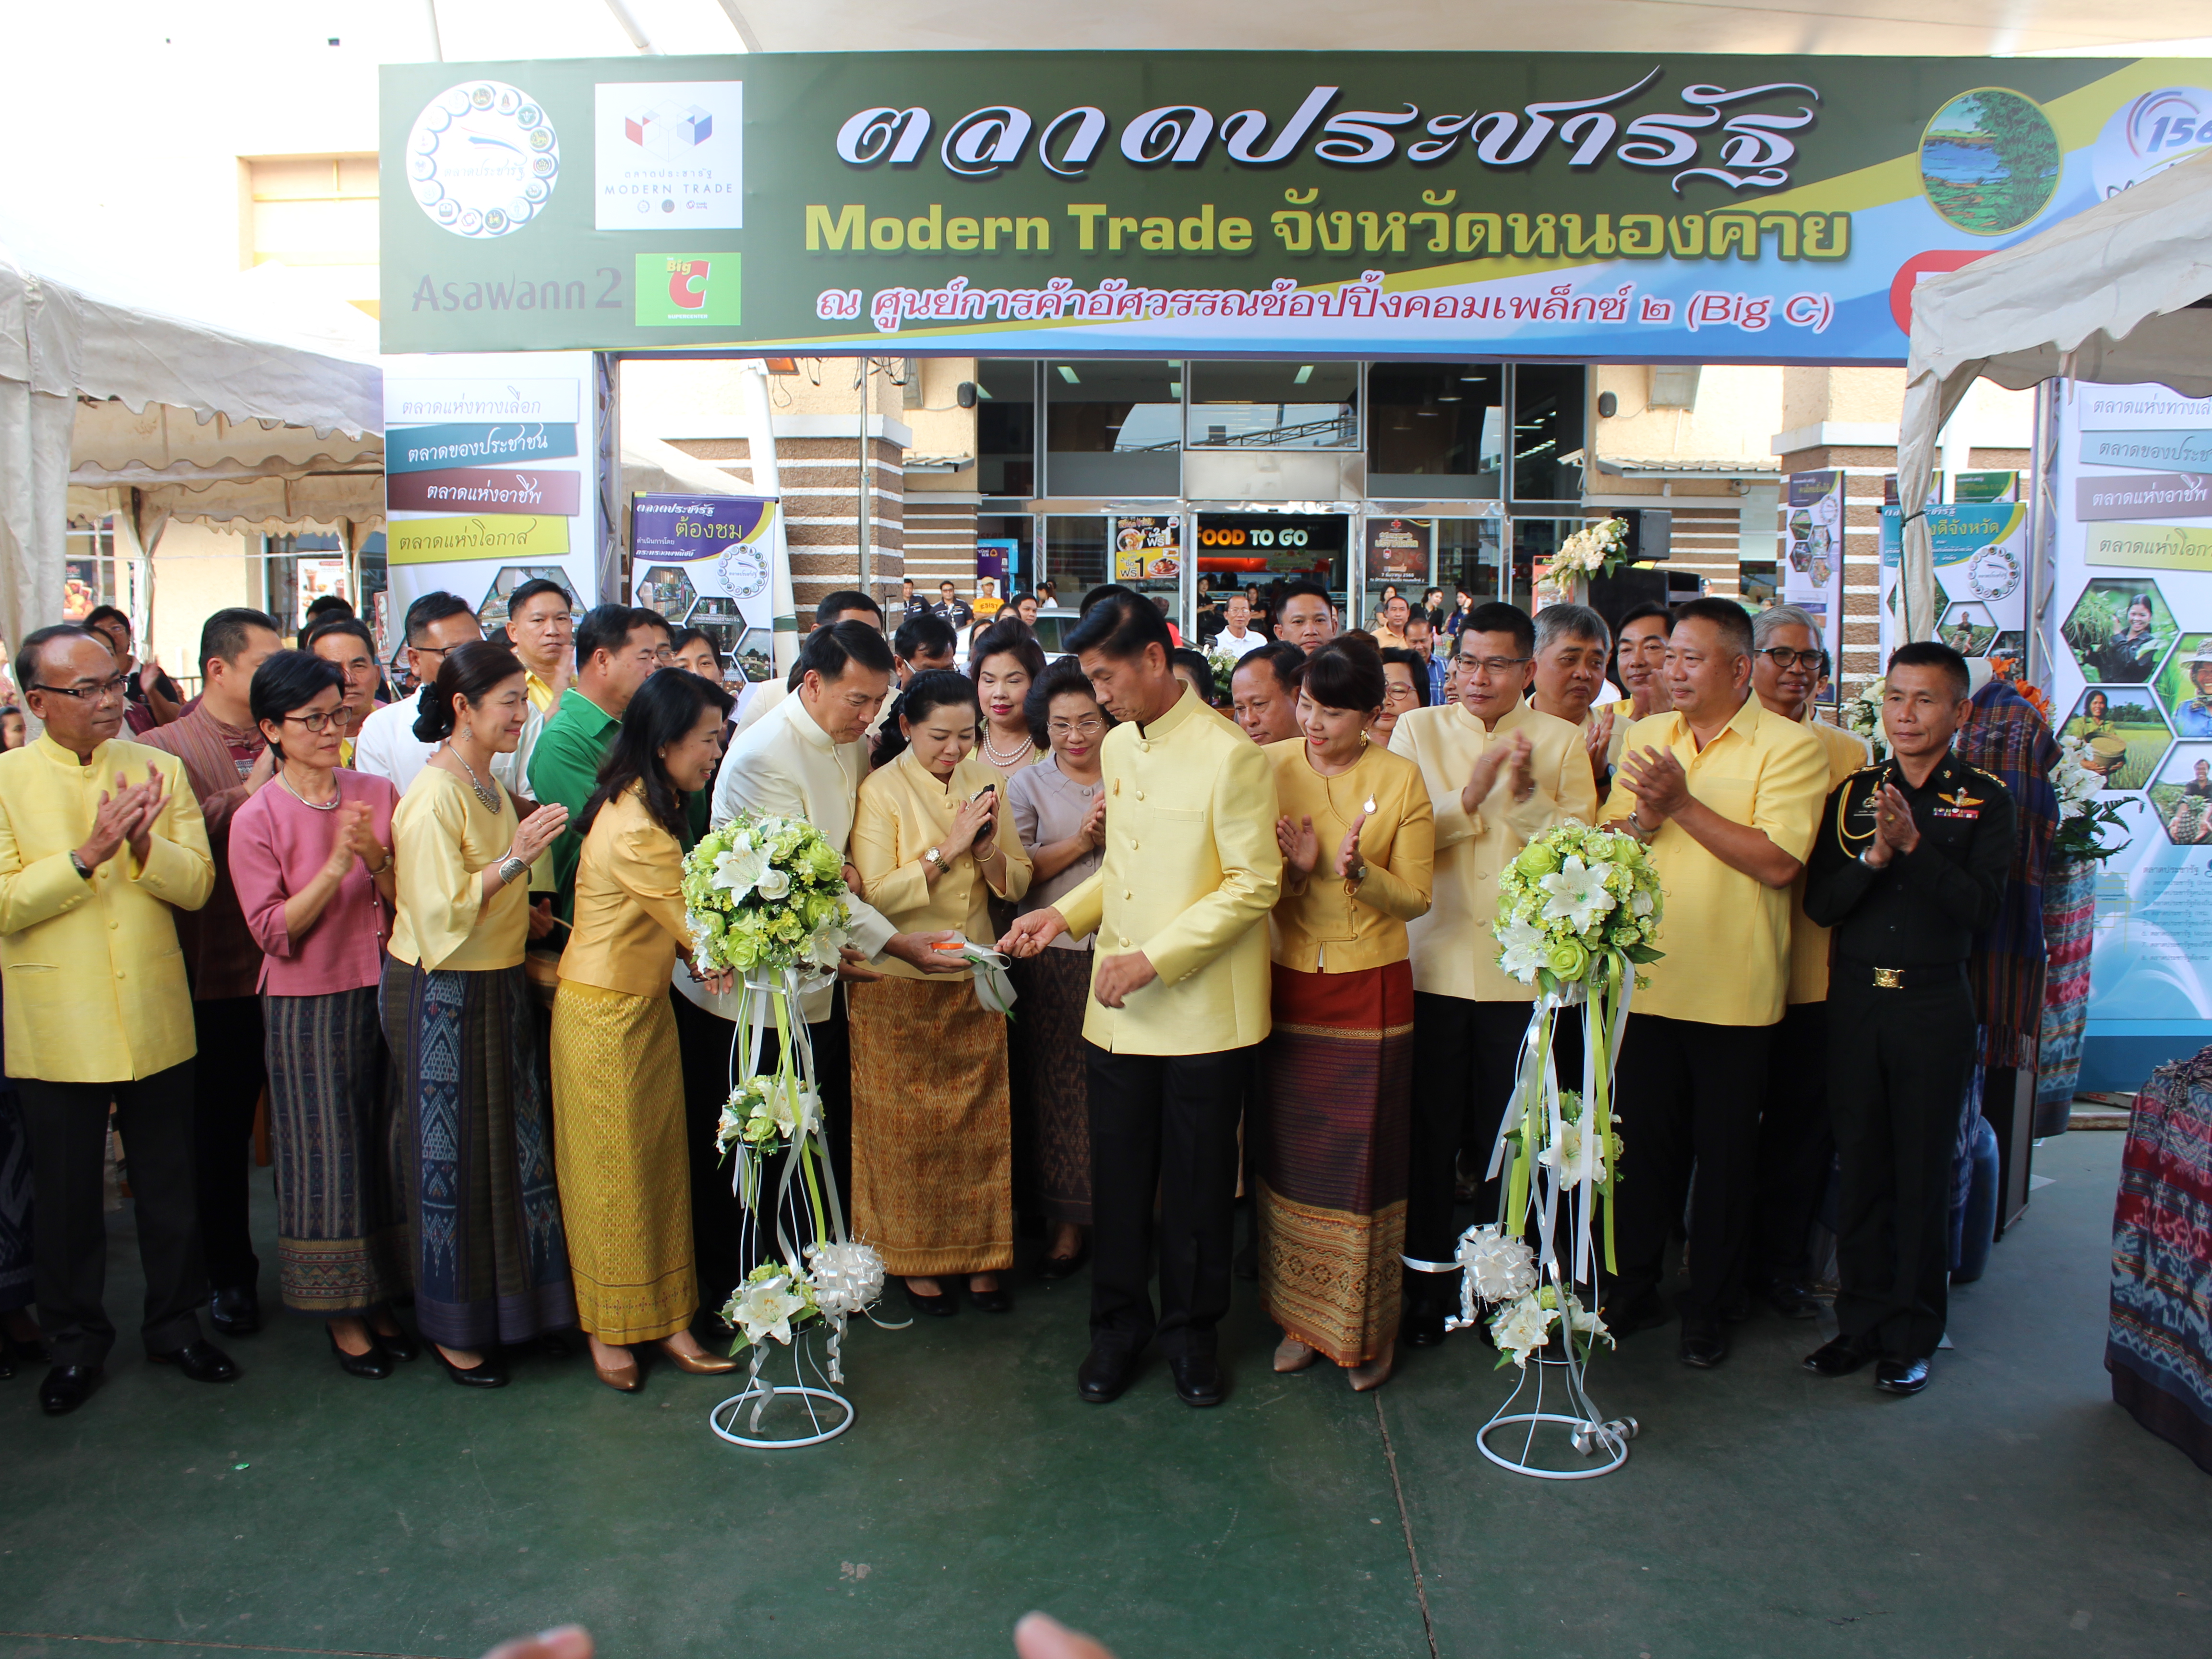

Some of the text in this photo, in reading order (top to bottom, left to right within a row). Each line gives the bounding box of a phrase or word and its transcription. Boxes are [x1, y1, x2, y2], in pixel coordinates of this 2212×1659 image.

[837, 65, 1818, 193] ตลาดประชารัฐ
[444, 158, 526, 181] ตลาดประชารัฐ
[625, 168, 712, 179] ตลาดประชารัฐ
[604, 183, 732, 195] MODERN TRADE
[805, 188, 1847, 257] Modern Trade จังหวัดหนองคาย
[412, 267, 623, 312] Asawann 2
[667, 260, 710, 310] Big C
[818, 291, 861, 318] ณ
[1639, 293, 1673, 322] ๒
[1685, 292, 1770, 332] (Big
[1785, 292, 1834, 334] C)
[403, 385, 541, 415] ตลาดแห่งทางเลือก
[2093, 393, 2212, 416] ตลาดแห่งทางเล
[408, 423, 548, 462] ตลาดของประชาชน
[427, 475, 542, 504] ตลาดแห่งอาชีพ
[2092, 474, 2208, 506] ตลาดแห่งอาชีพ
[637, 503, 715, 517] ตลาดประชารัฐ
[400, 518, 537, 550] ตลาดแห่งโอกาส
[637, 537, 675, 545] ดำเนินการโดย
[675, 516, 742, 540] ต้องชม
[1250, 529, 1274, 546] TO
[1279, 528, 1308, 546] GO
[636, 548, 697, 557] กระทรวงพาณิชย์
[1134, 556, 1144, 578] 1
